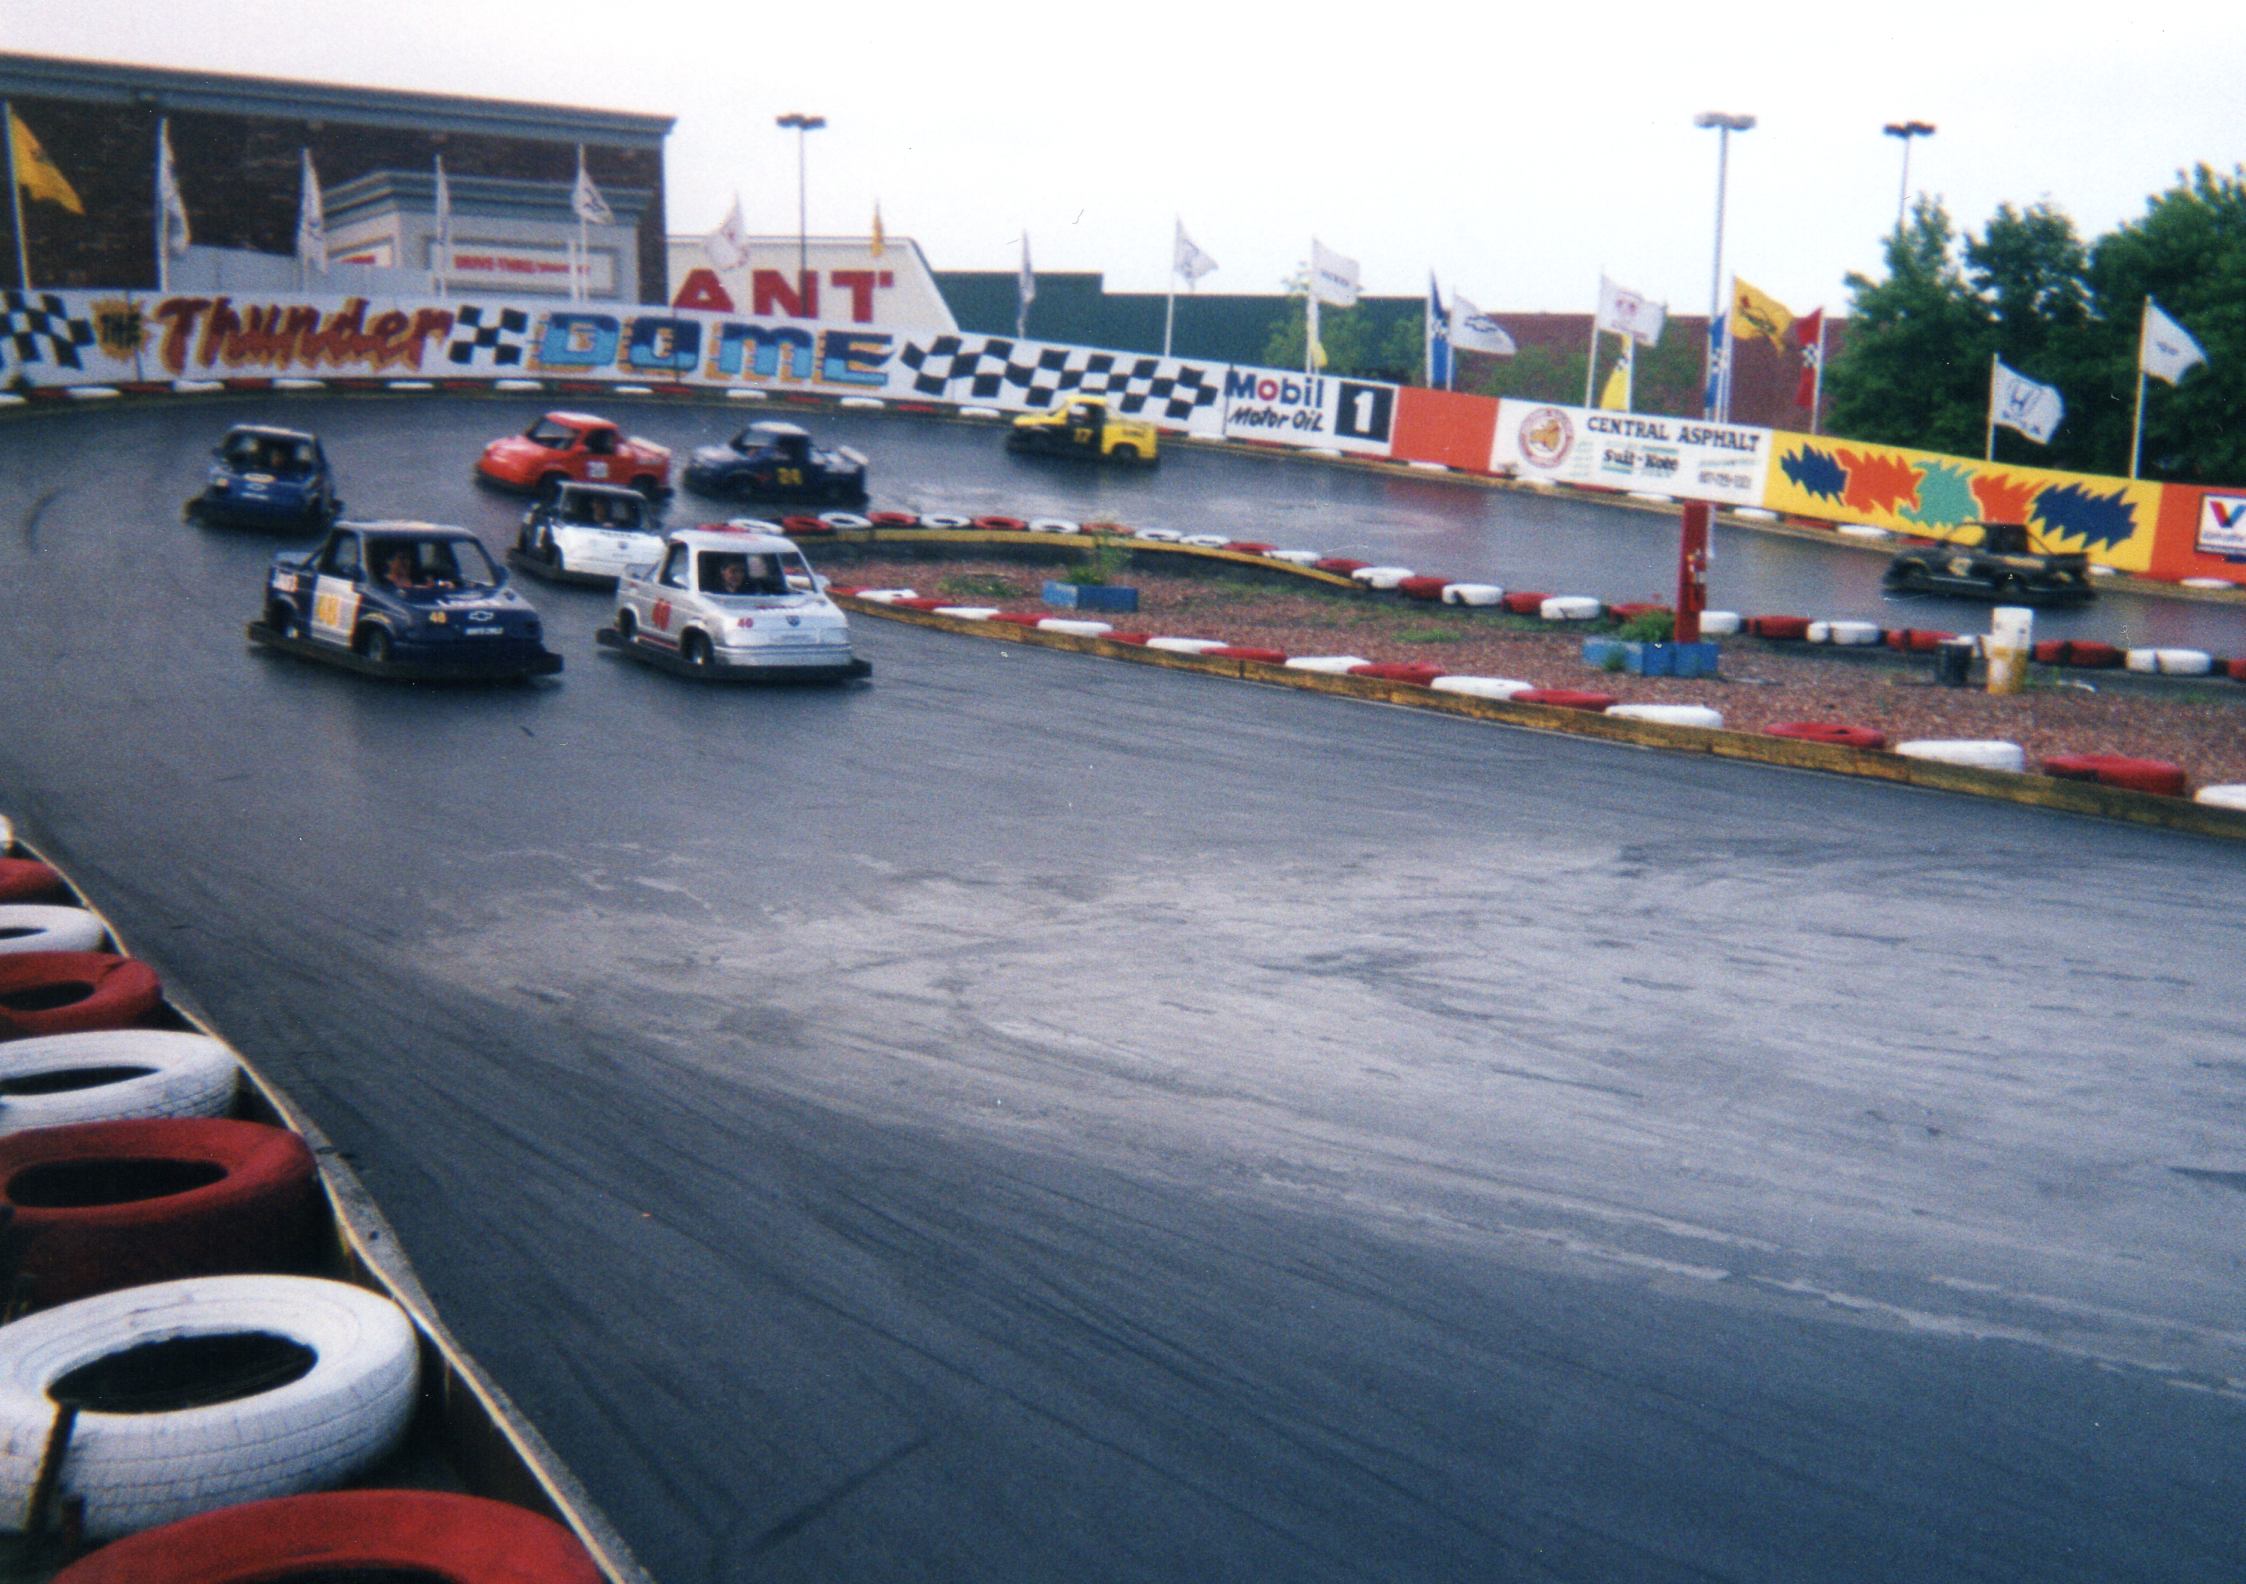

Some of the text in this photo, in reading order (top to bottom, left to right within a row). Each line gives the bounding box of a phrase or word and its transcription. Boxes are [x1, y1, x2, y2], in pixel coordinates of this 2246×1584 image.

[672, 269, 895, 322] ANT
[153, 297, 455, 375] Thunder
[1224, 369, 1325, 409] Mobil
[1229, 405, 1290, 429] Motor
[1587, 416, 1670, 441] CENTRAL
[1676, 426, 1761, 452] ASPHALT
